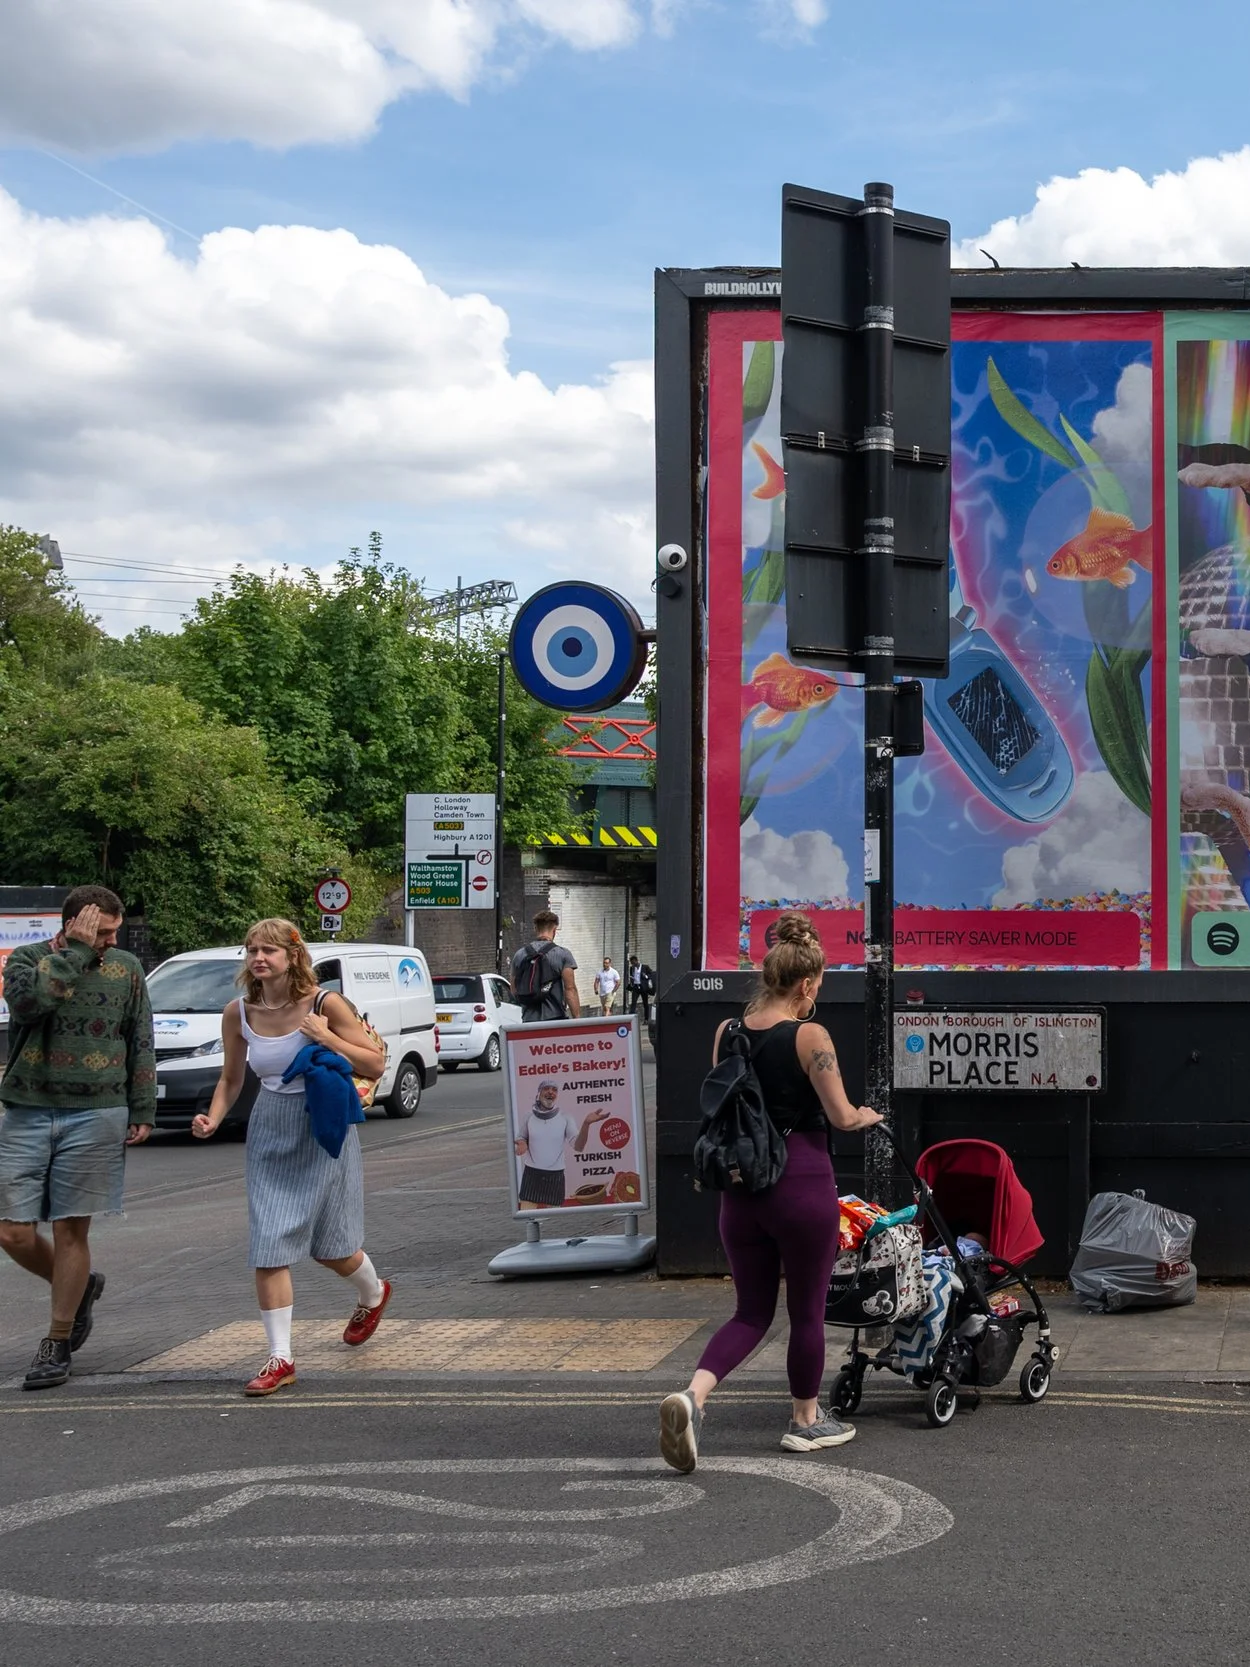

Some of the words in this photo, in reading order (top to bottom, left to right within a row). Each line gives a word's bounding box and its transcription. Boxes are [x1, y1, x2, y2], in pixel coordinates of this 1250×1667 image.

[434, 804, 468, 812] Holloway
[437, 897, 460, 905] (A10)
[896, 931, 966, 945] BATTERY
[968, 931, 1021, 946] SAVER
[1025, 932, 1077, 946] MODE
[693, 977, 724, 990] 9018
[894, 1016, 939, 1026] ONDON
[947, 1016, 1004, 1027] BOROUGH
[1013, 1017, 1028, 1026] OF
[1035, 1017, 1097, 1028] ISLINGTON
[529, 1042, 595, 1056] Welcome
[599, 1040, 613, 1051] to
[929, 1032, 1040, 1058] MORRIS
[518, 1061, 570, 1076] Eddie's
[572, 1057, 626, 1073] Bakery!
[929, 1061, 1020, 1086] PLACE
[562, 1078, 626, 1091] AUTHENTIC
[576, 1093, 613, 1104] FRESH
[603, 1121, 622, 1133] MENU
[605, 1132, 628, 1146] REVERSE
[574, 1151, 622, 1163] TURKISH
[582, 1166, 615, 1177] PIZZA
[833, 1283, 860, 1291] MOUE
